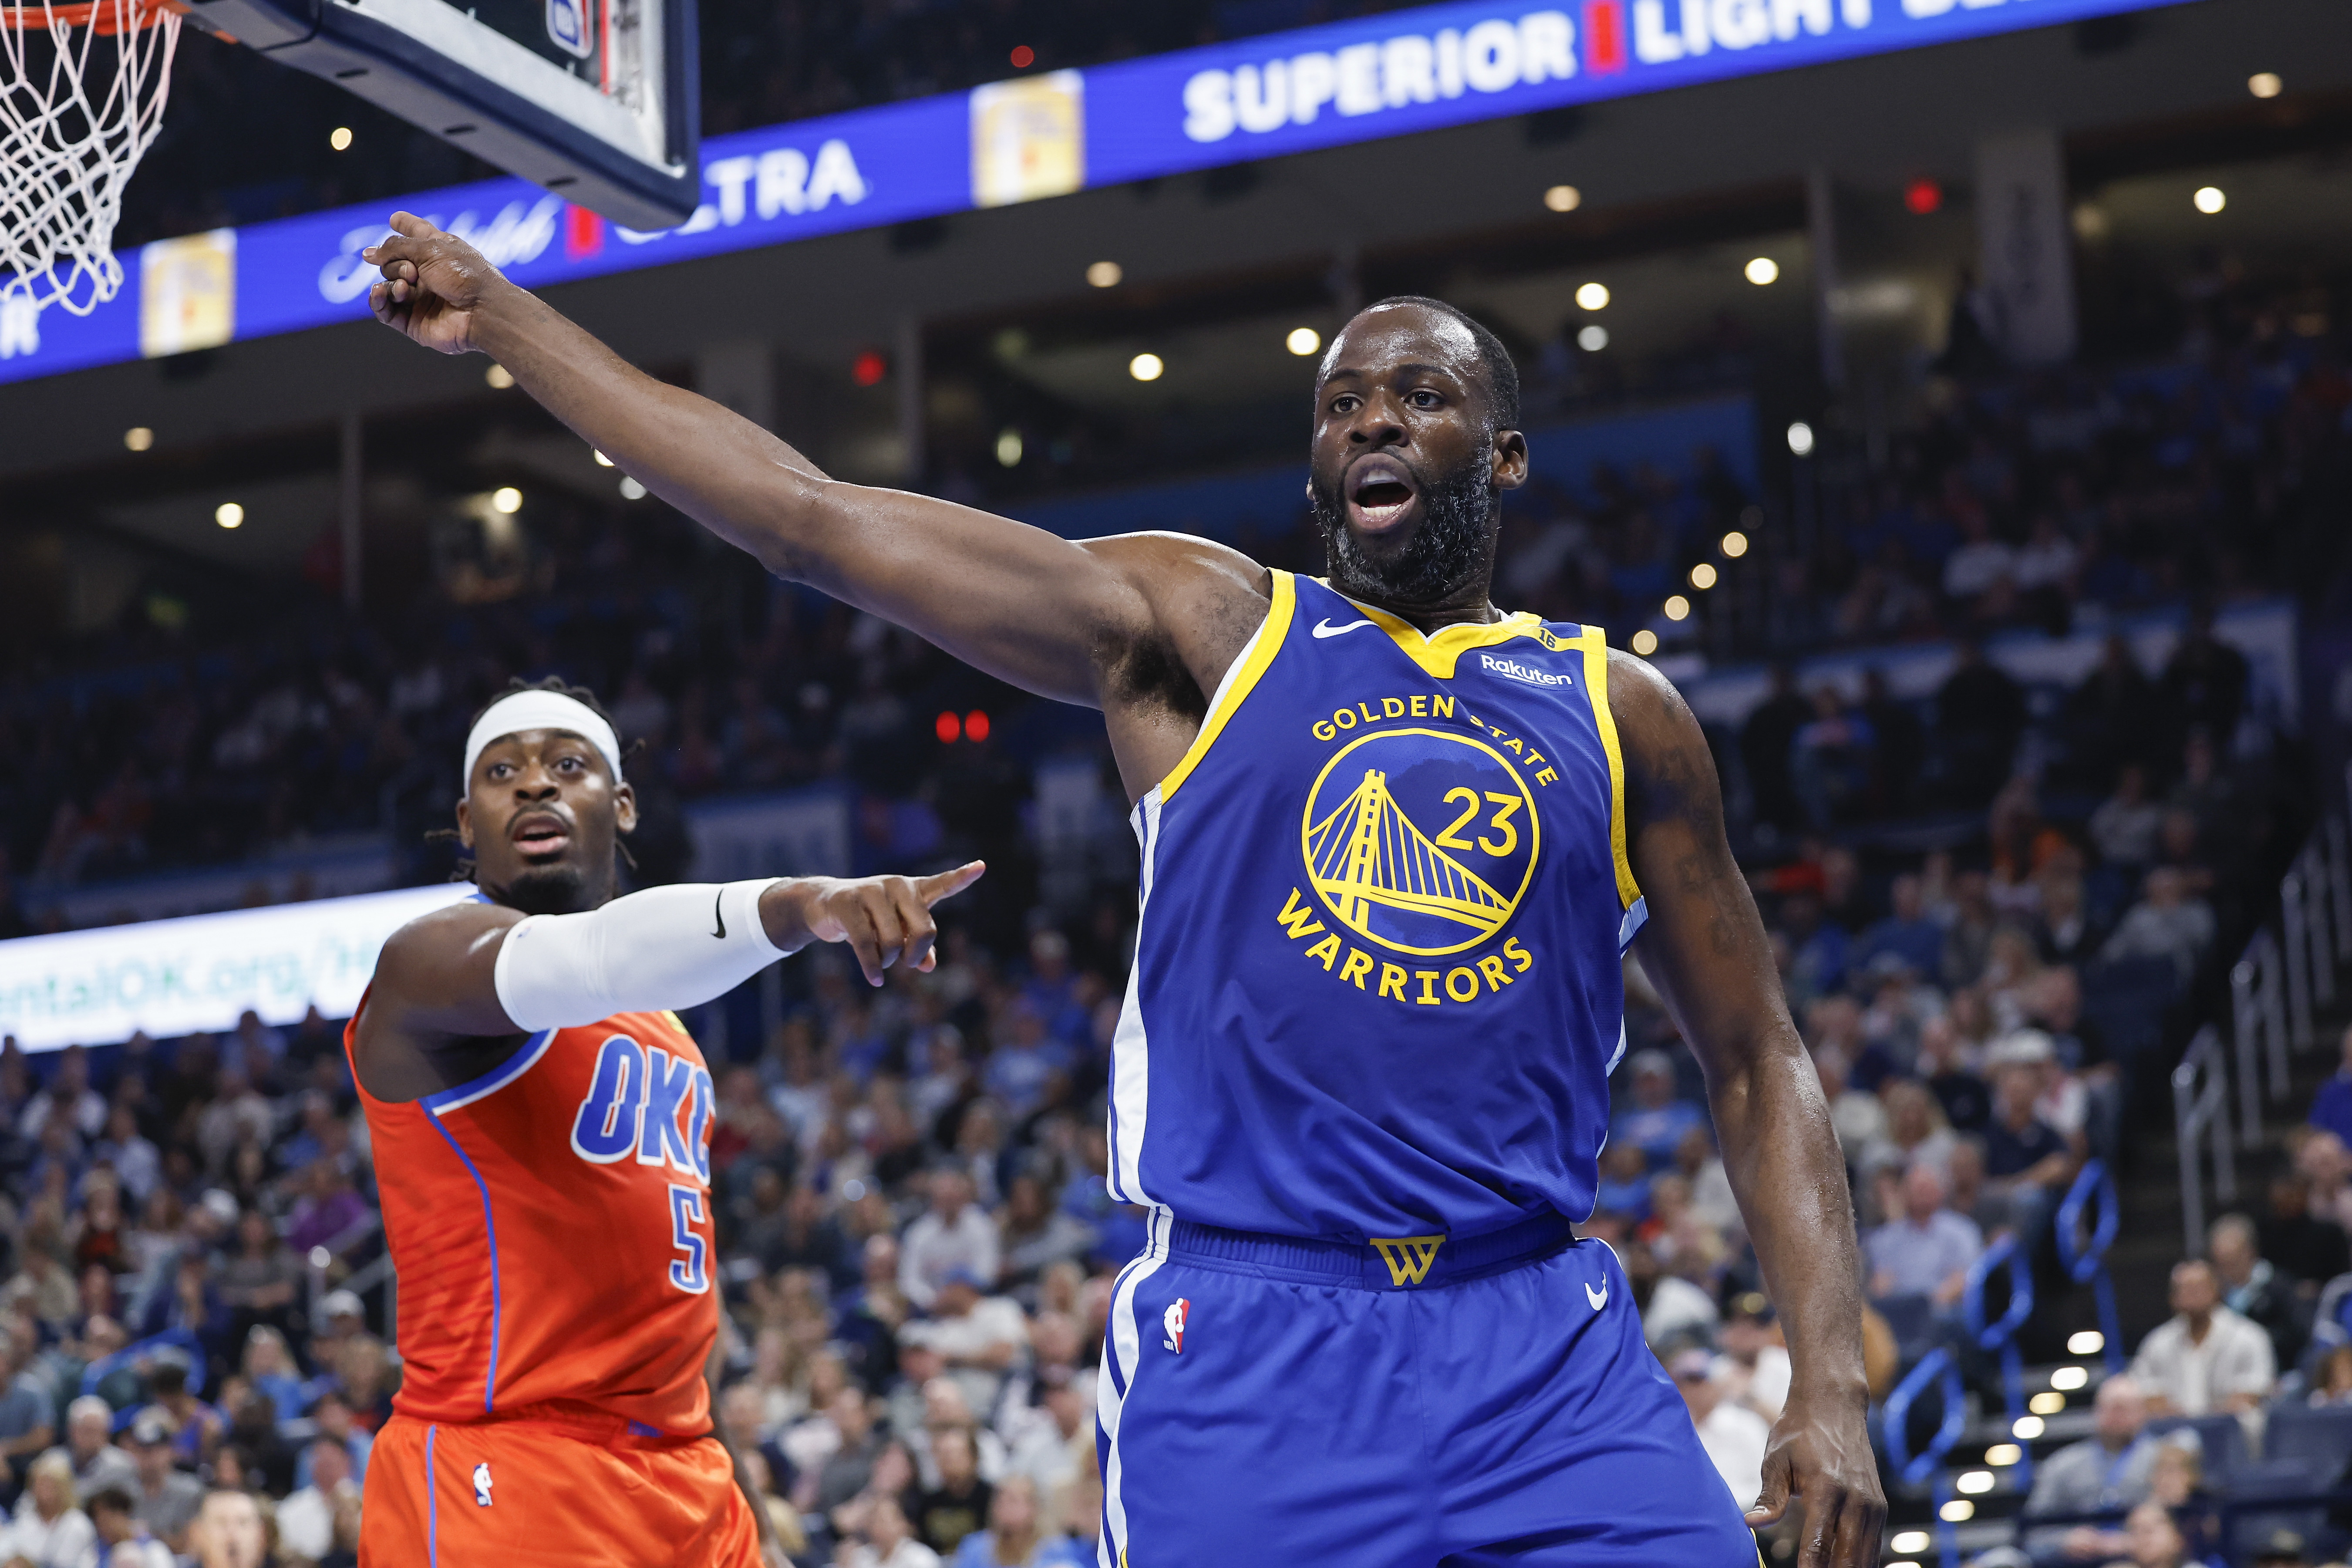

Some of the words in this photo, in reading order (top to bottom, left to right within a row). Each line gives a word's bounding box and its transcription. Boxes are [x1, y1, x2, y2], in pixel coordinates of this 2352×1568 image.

[1183, 10, 1577, 142] SUPERIOR
[614, 138, 867, 245] TRA
[1481, 654, 1572, 686] Rakuten
[1539, 629, 1556, 648] 16
[1312, 694, 1455, 742] GOLDEN
[1469, 715, 1559, 787] STATE
[1435, 786, 1523, 857] 23
[1277, 887, 1533, 1005] WARRIORS
[668, 1183, 710, 1294] 5
[1163, 1339, 1174, 1351] NBA
